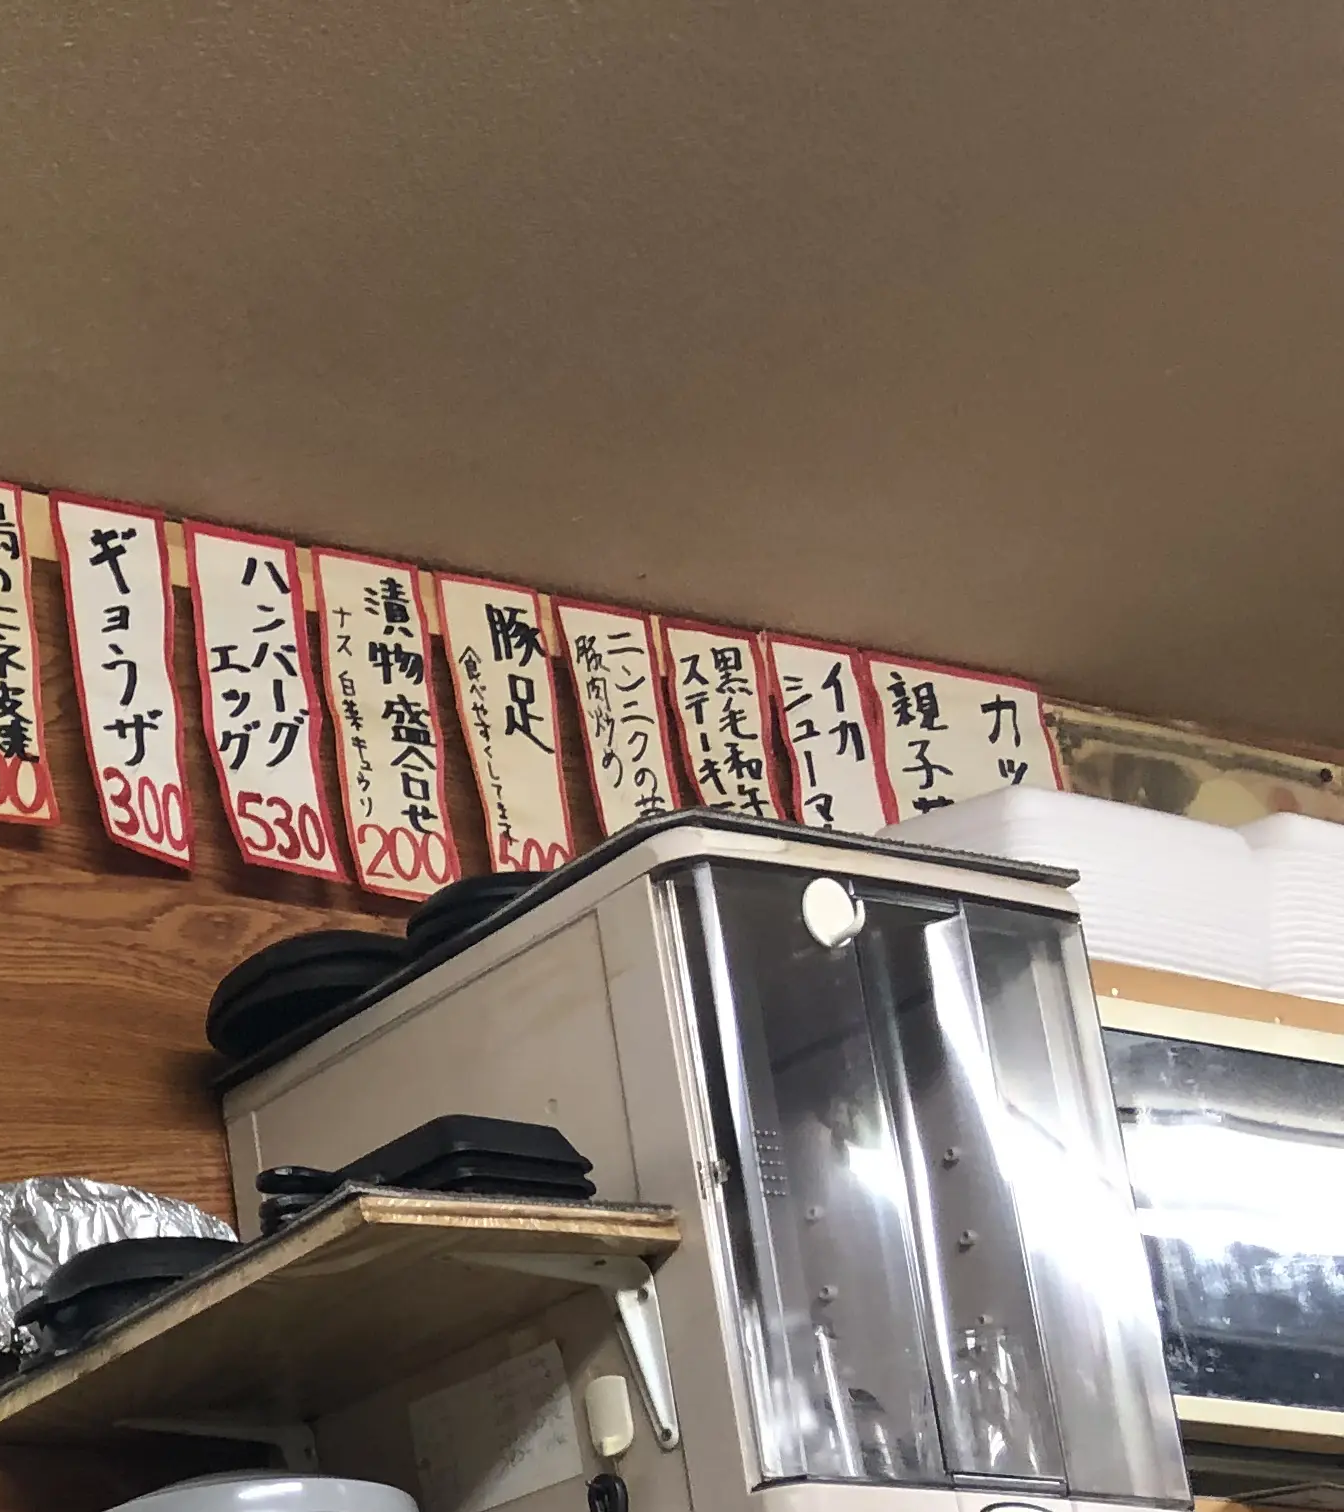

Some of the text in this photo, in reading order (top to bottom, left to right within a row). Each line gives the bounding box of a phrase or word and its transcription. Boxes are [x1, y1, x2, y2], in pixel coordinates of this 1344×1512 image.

[210, 645, 262, 771] エッグ
[241, 557, 311, 768] ハンバーグ
[486, 603, 555, 754] 豚足
[821, 661, 866, 761] イカ
[103, 767, 189, 851] 300
[237, 792, 324, 860] 530
[358, 824, 453, 884] 200
